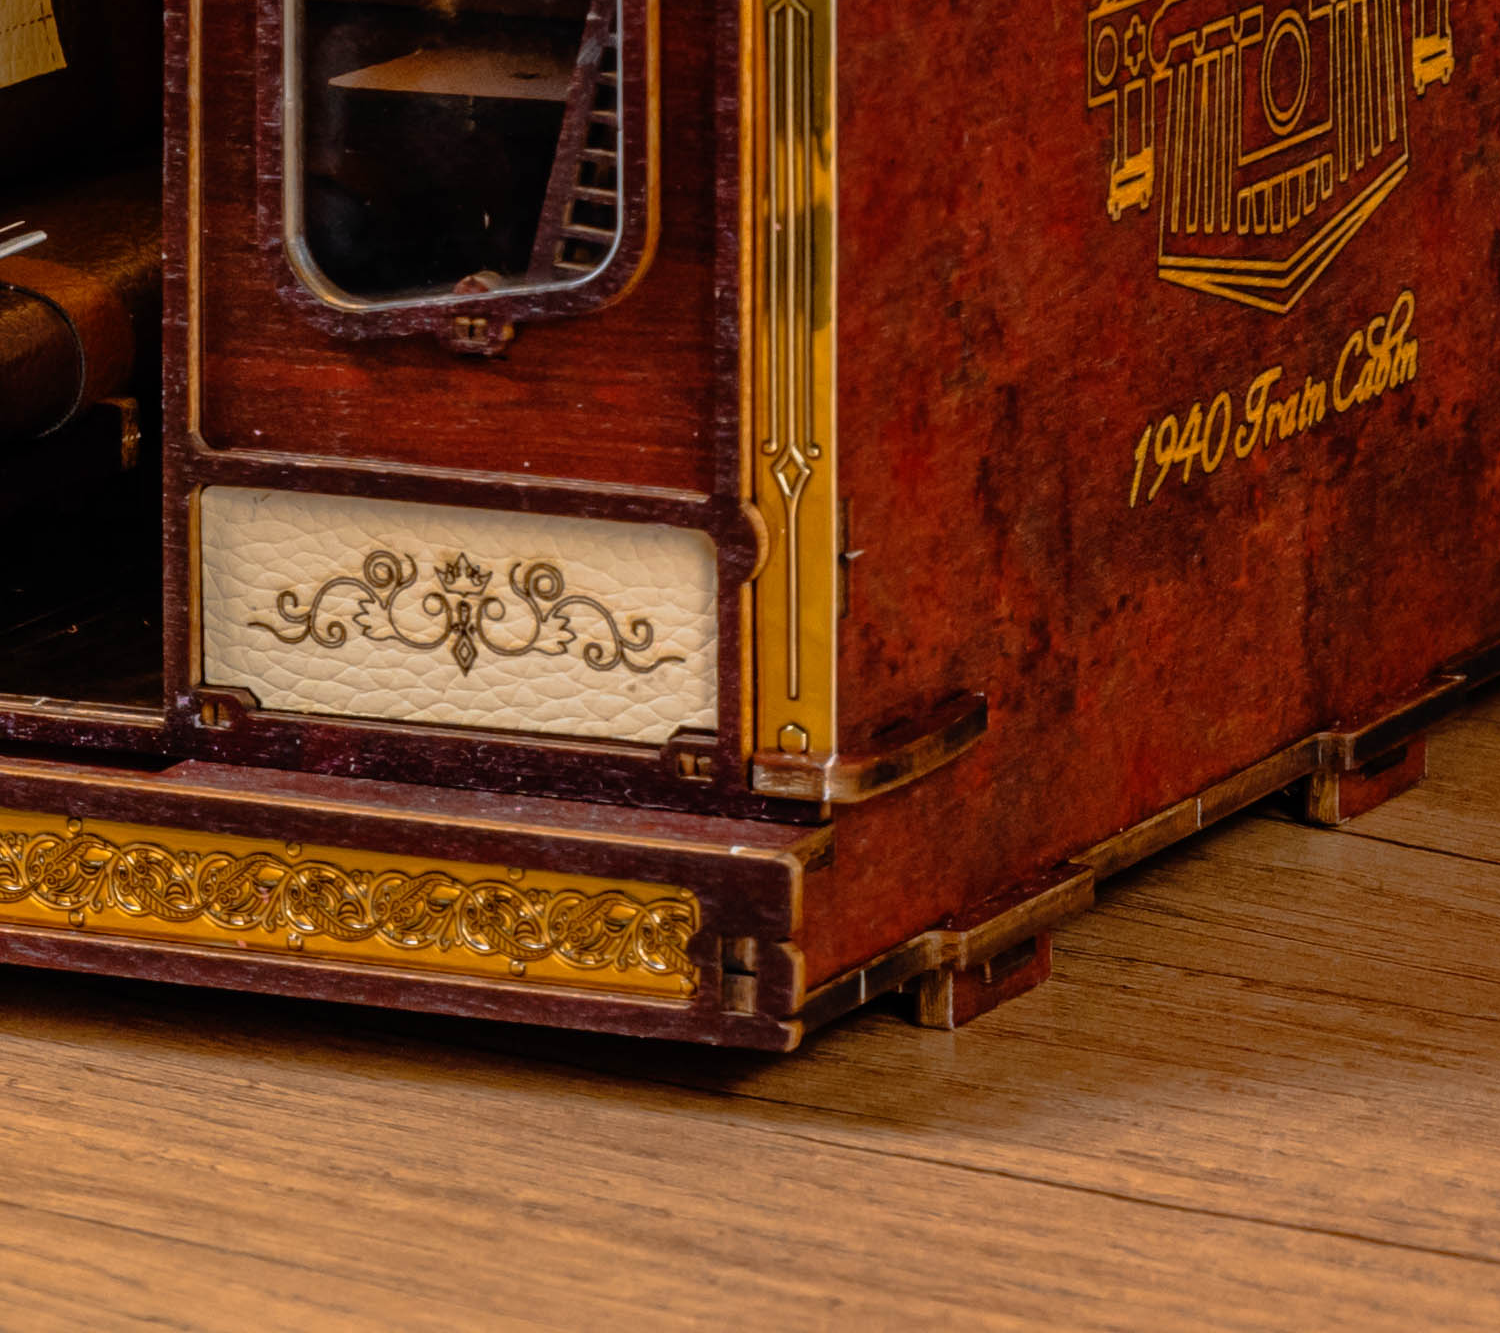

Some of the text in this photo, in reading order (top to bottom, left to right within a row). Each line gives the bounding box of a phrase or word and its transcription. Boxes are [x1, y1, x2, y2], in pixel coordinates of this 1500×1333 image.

[1130, 289, 1418, 508] 1940 Train Cabin
